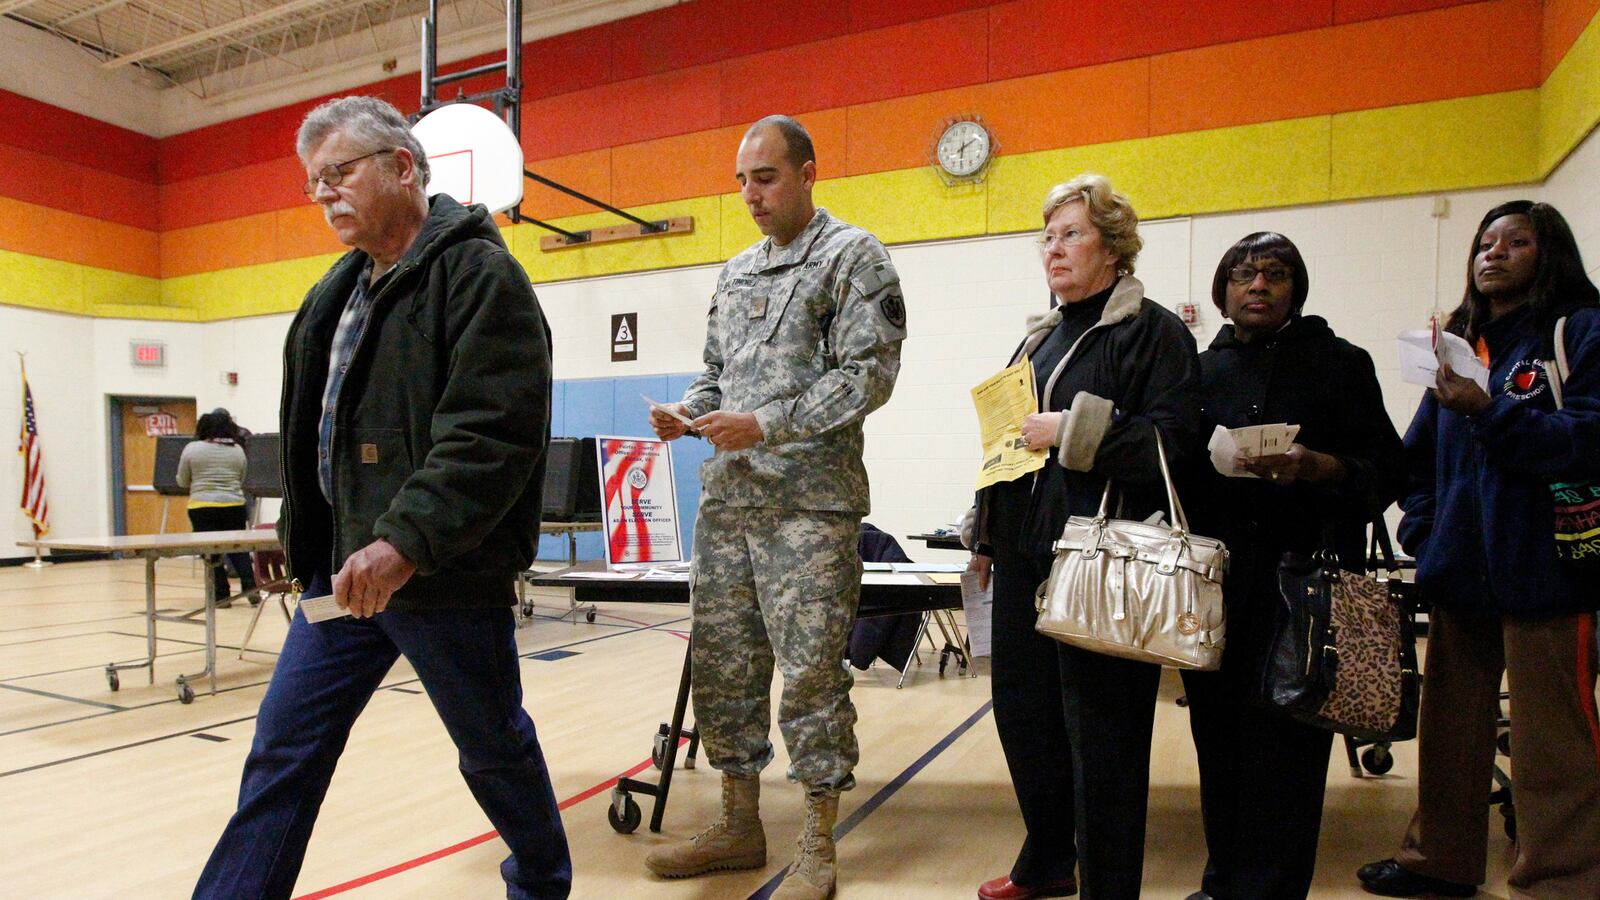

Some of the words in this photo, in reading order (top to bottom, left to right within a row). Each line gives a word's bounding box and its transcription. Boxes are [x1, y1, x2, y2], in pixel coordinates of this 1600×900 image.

[803, 260, 823, 271] ARMY
[620, 325, 629, 340] 3
[136, 346, 159, 362] EXIT
[150, 415, 176, 428] EXIT
